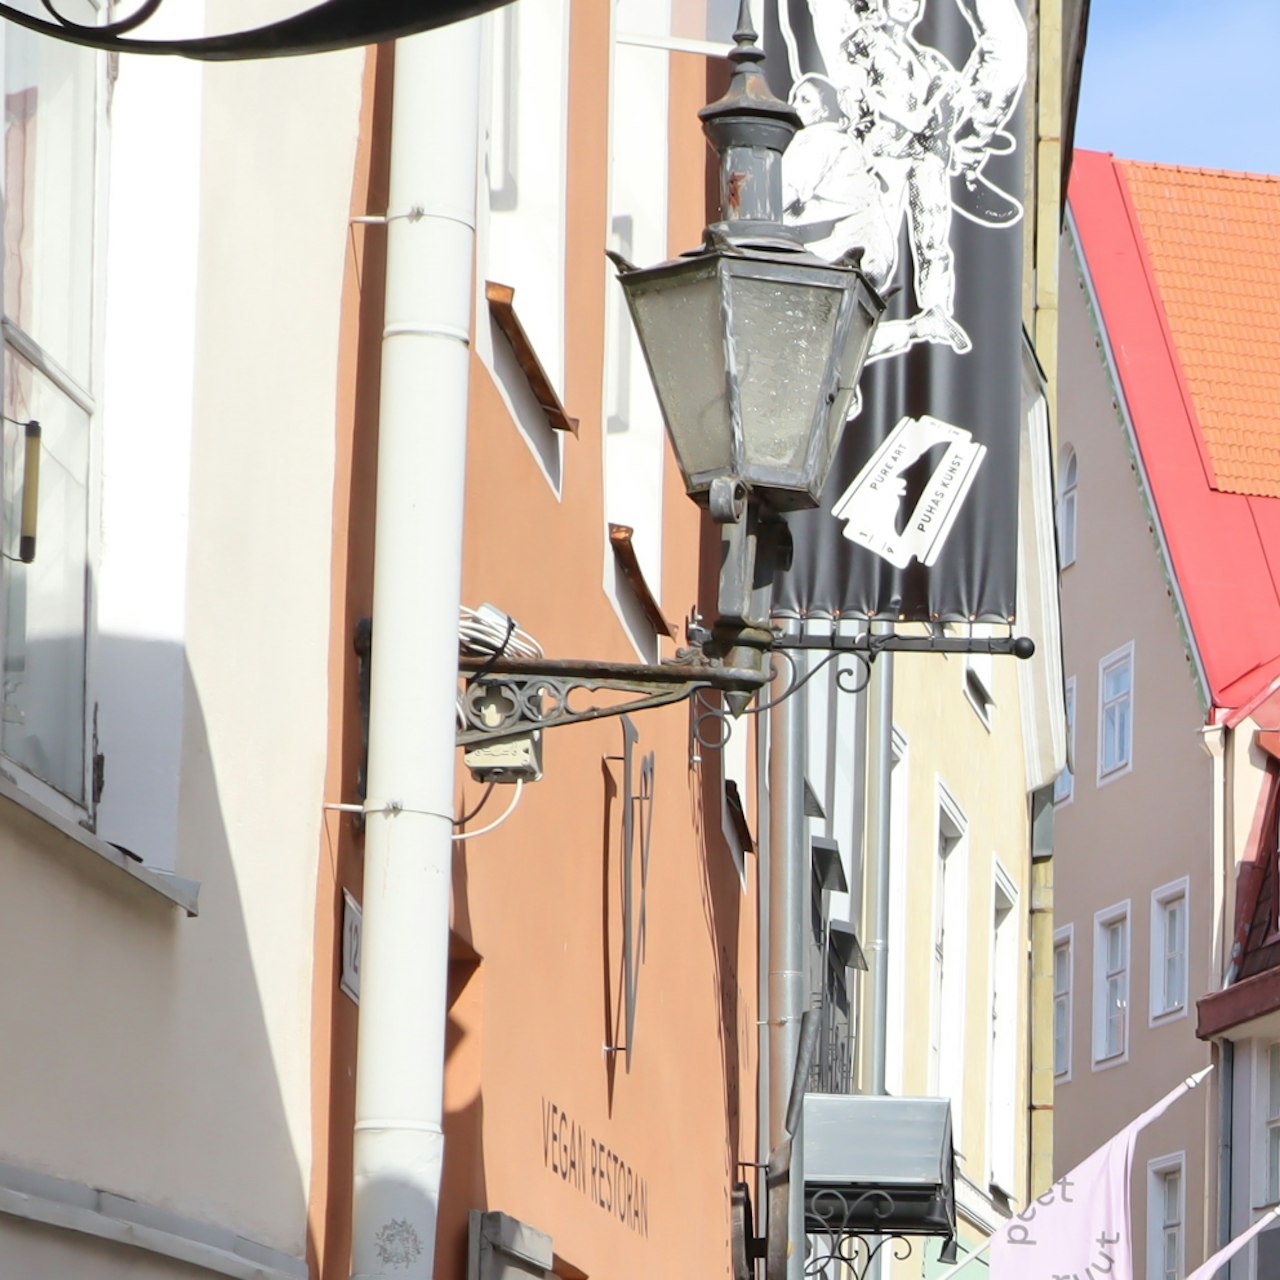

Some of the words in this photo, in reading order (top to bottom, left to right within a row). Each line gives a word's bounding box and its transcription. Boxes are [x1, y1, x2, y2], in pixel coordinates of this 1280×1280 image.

[869, 463, 893, 490] PURE
[892, 443, 908, 464] ART
[917, 490, 945, 533] PUHAS
[941, 454, 965, 489] KUNST
[541, 1096, 587, 1195] VEGAN
[590, 1137, 649, 1240] RESTORAN
